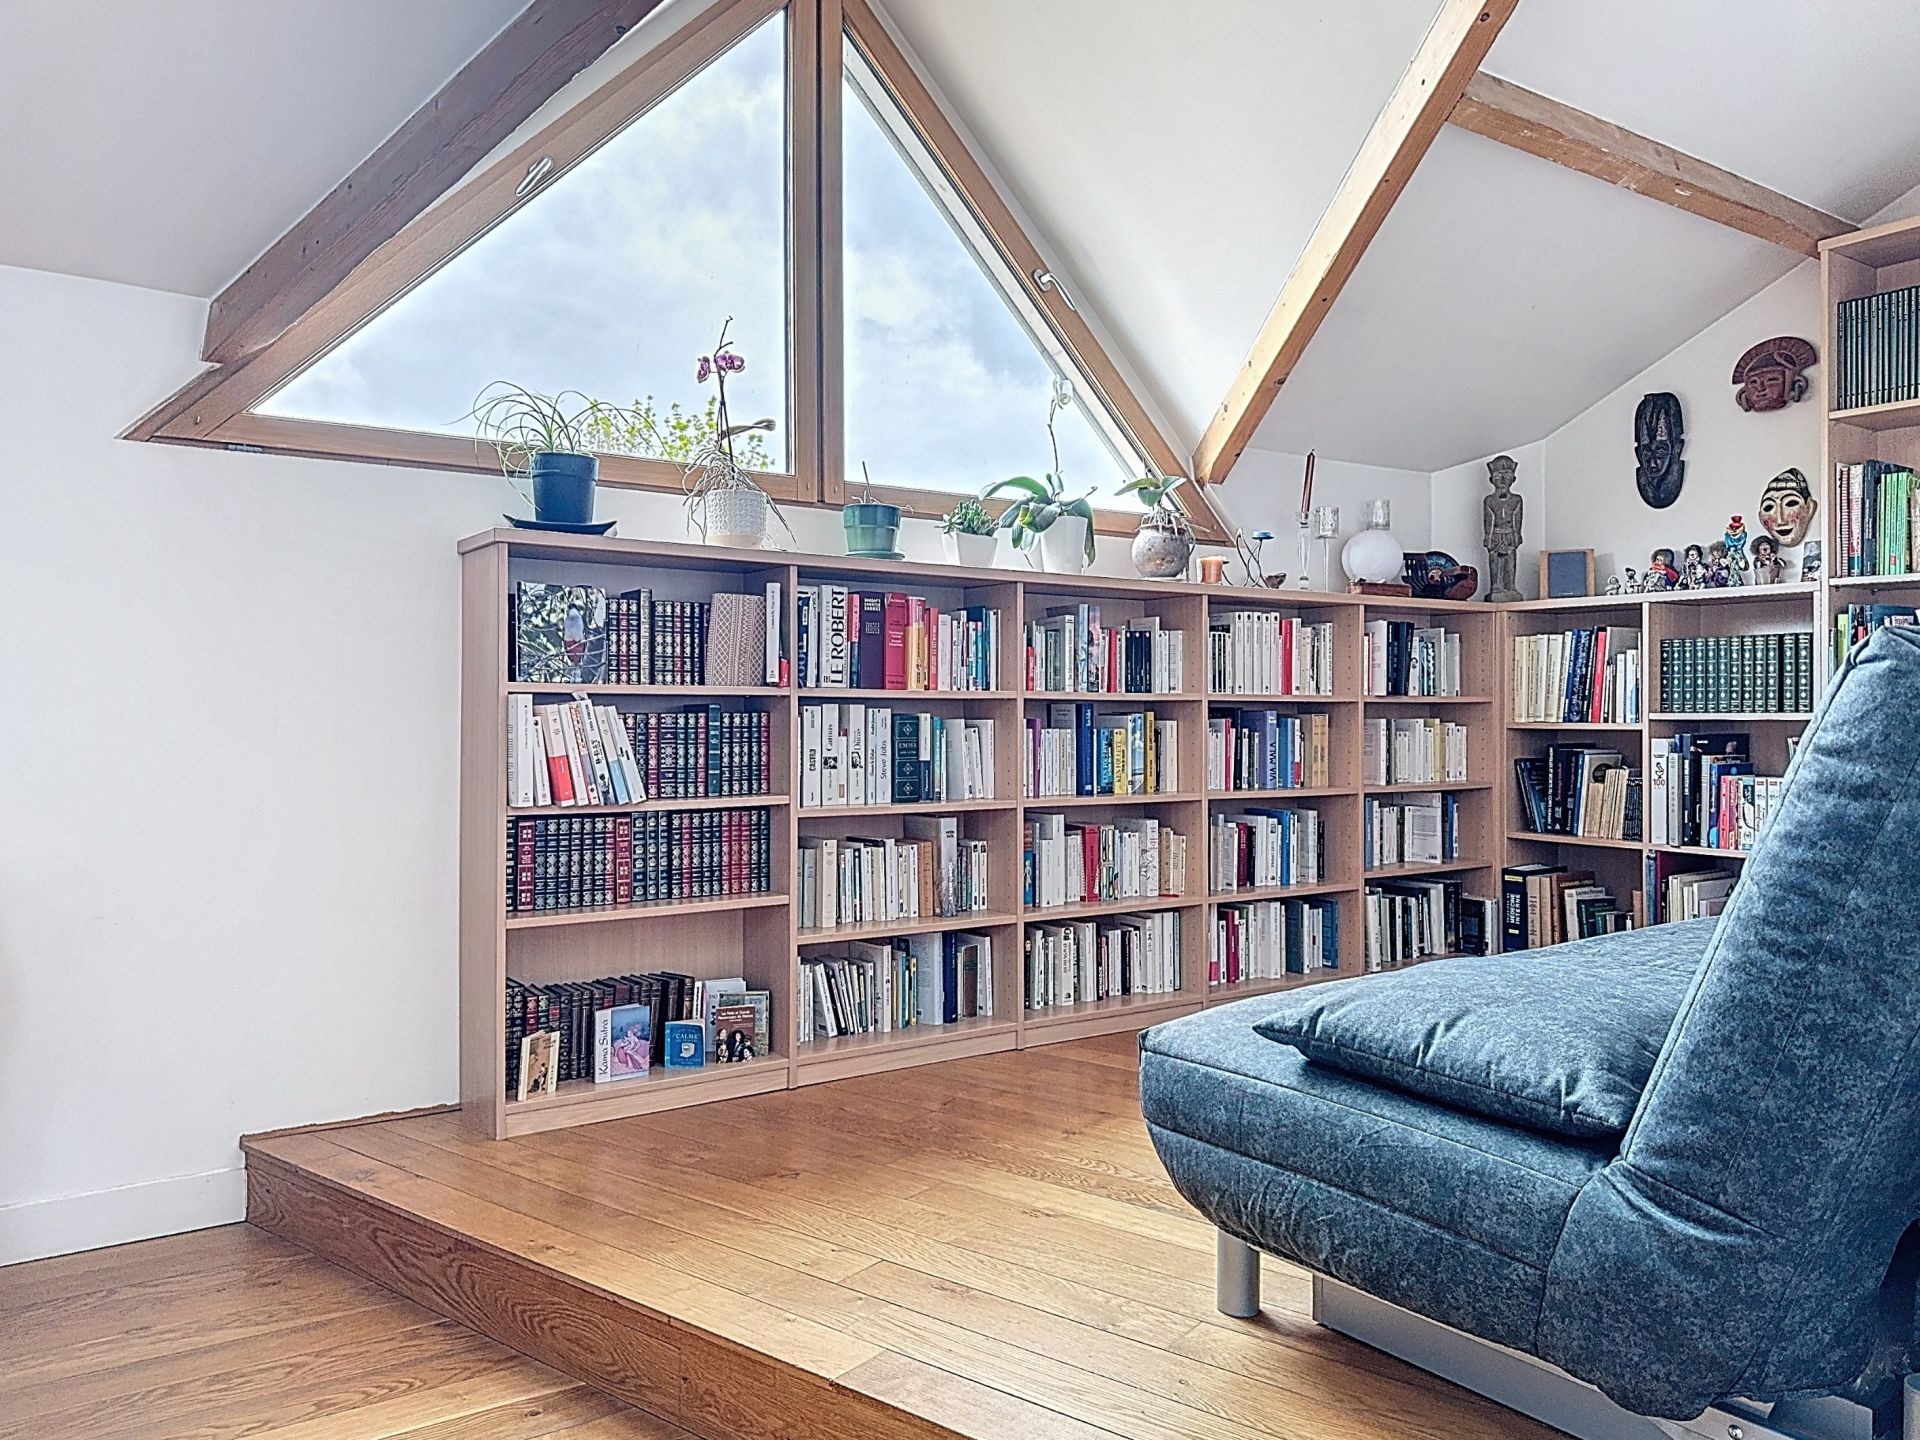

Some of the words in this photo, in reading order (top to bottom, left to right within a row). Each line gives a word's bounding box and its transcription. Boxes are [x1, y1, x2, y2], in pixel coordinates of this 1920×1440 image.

[830, 588, 844, 660] ROBERT
[830, 663, 844, 684] LE
[825, 723, 833, 752] Camus
[854, 728, 862, 751] Duras
[809, 748, 817, 772] CASTRO
[1269, 741, 1277, 765] MALA
[1269, 767, 1277, 782] VIA
[1653, 778, 1666, 787] 100
[598, 1019, 609, 1046] Sutra
[599, 1047, 609, 1075] Kama
